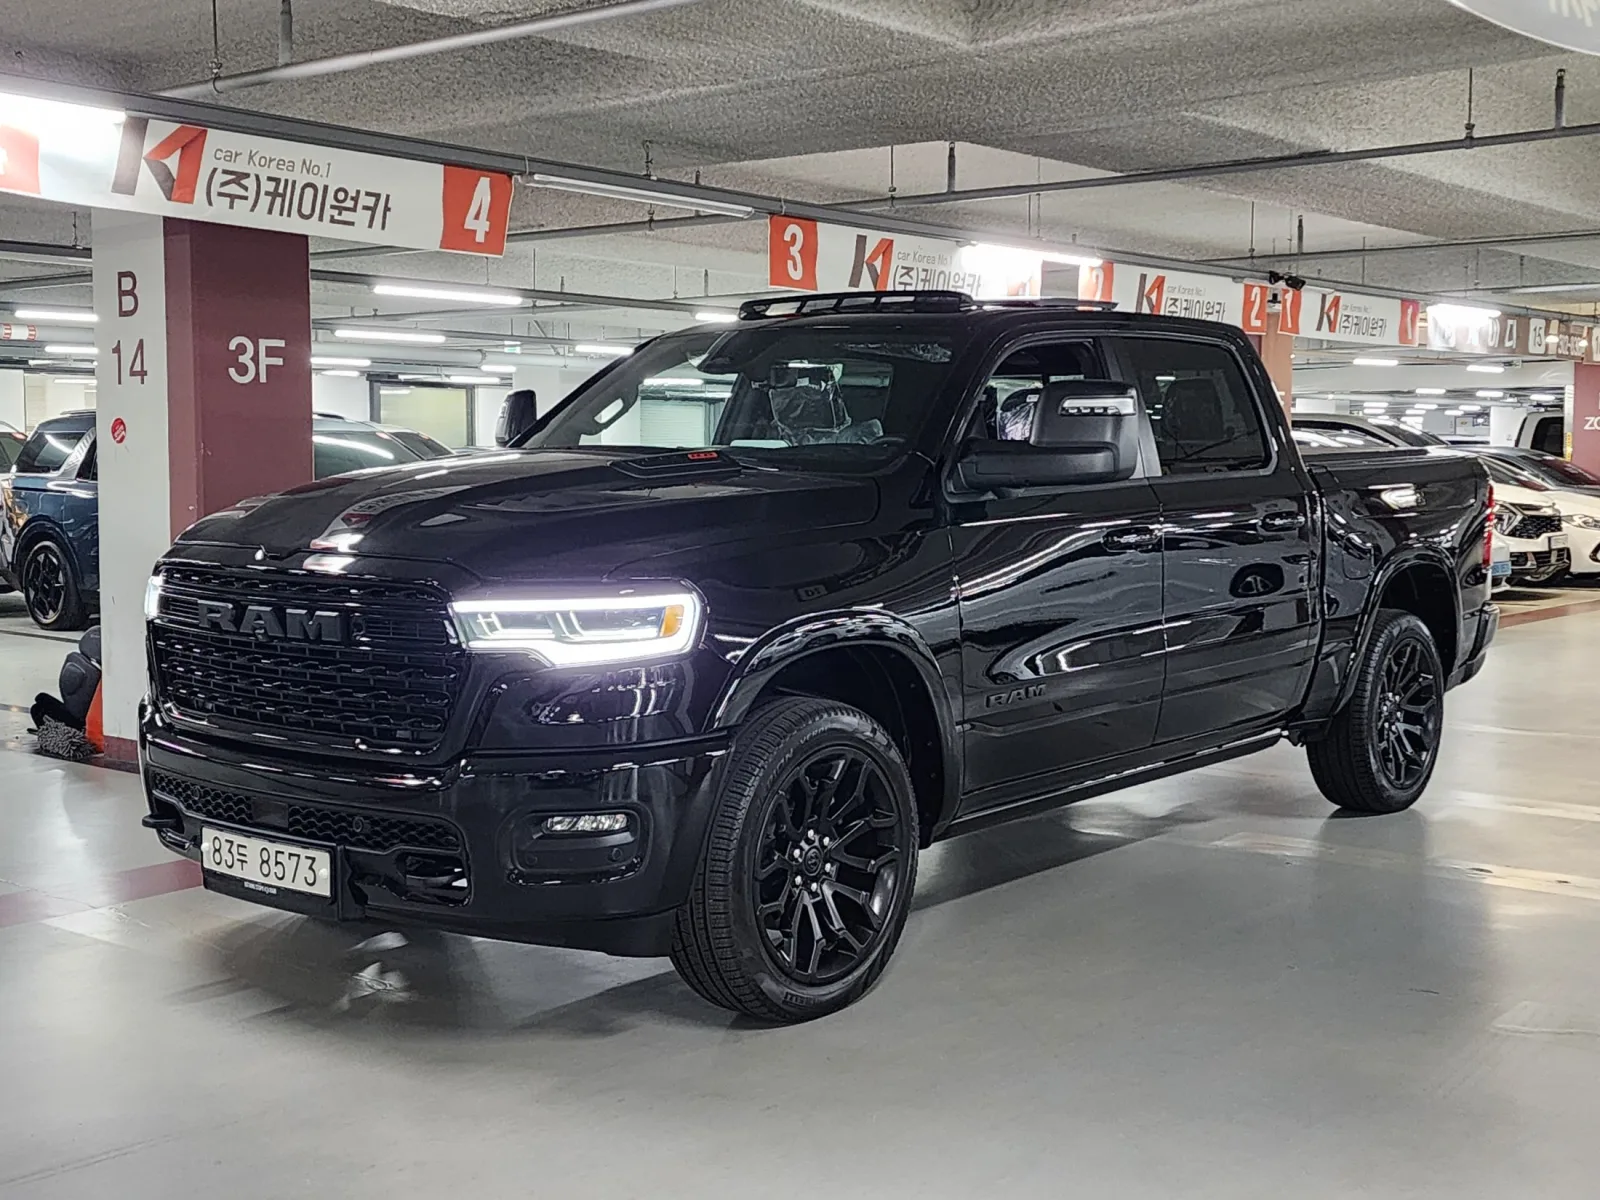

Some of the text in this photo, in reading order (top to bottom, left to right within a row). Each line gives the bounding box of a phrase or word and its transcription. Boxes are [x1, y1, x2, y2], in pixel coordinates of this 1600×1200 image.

[213, 147, 332, 179] car Korea No.1
[205, 166, 392, 231] (주)케이원카
[464, 176, 493, 244] 4
[783, 223, 805, 281] 3
[896, 251, 911, 263] car
[912, 250, 936, 266] Korea
[116, 271, 139, 318] B
[1250, 286, 1262, 328] 2
[1284, 288, 1293, 328] 1
[1406, 305, 1414, 340] 1
[1533, 326, 1543, 348] 15
[111, 338, 148, 385] 14
[227, 336, 286, 384] 3F
[197, 599, 343, 642] RAM
[985, 681, 1047, 709] RAM
[211, 835, 317, 887] 83두 8573
